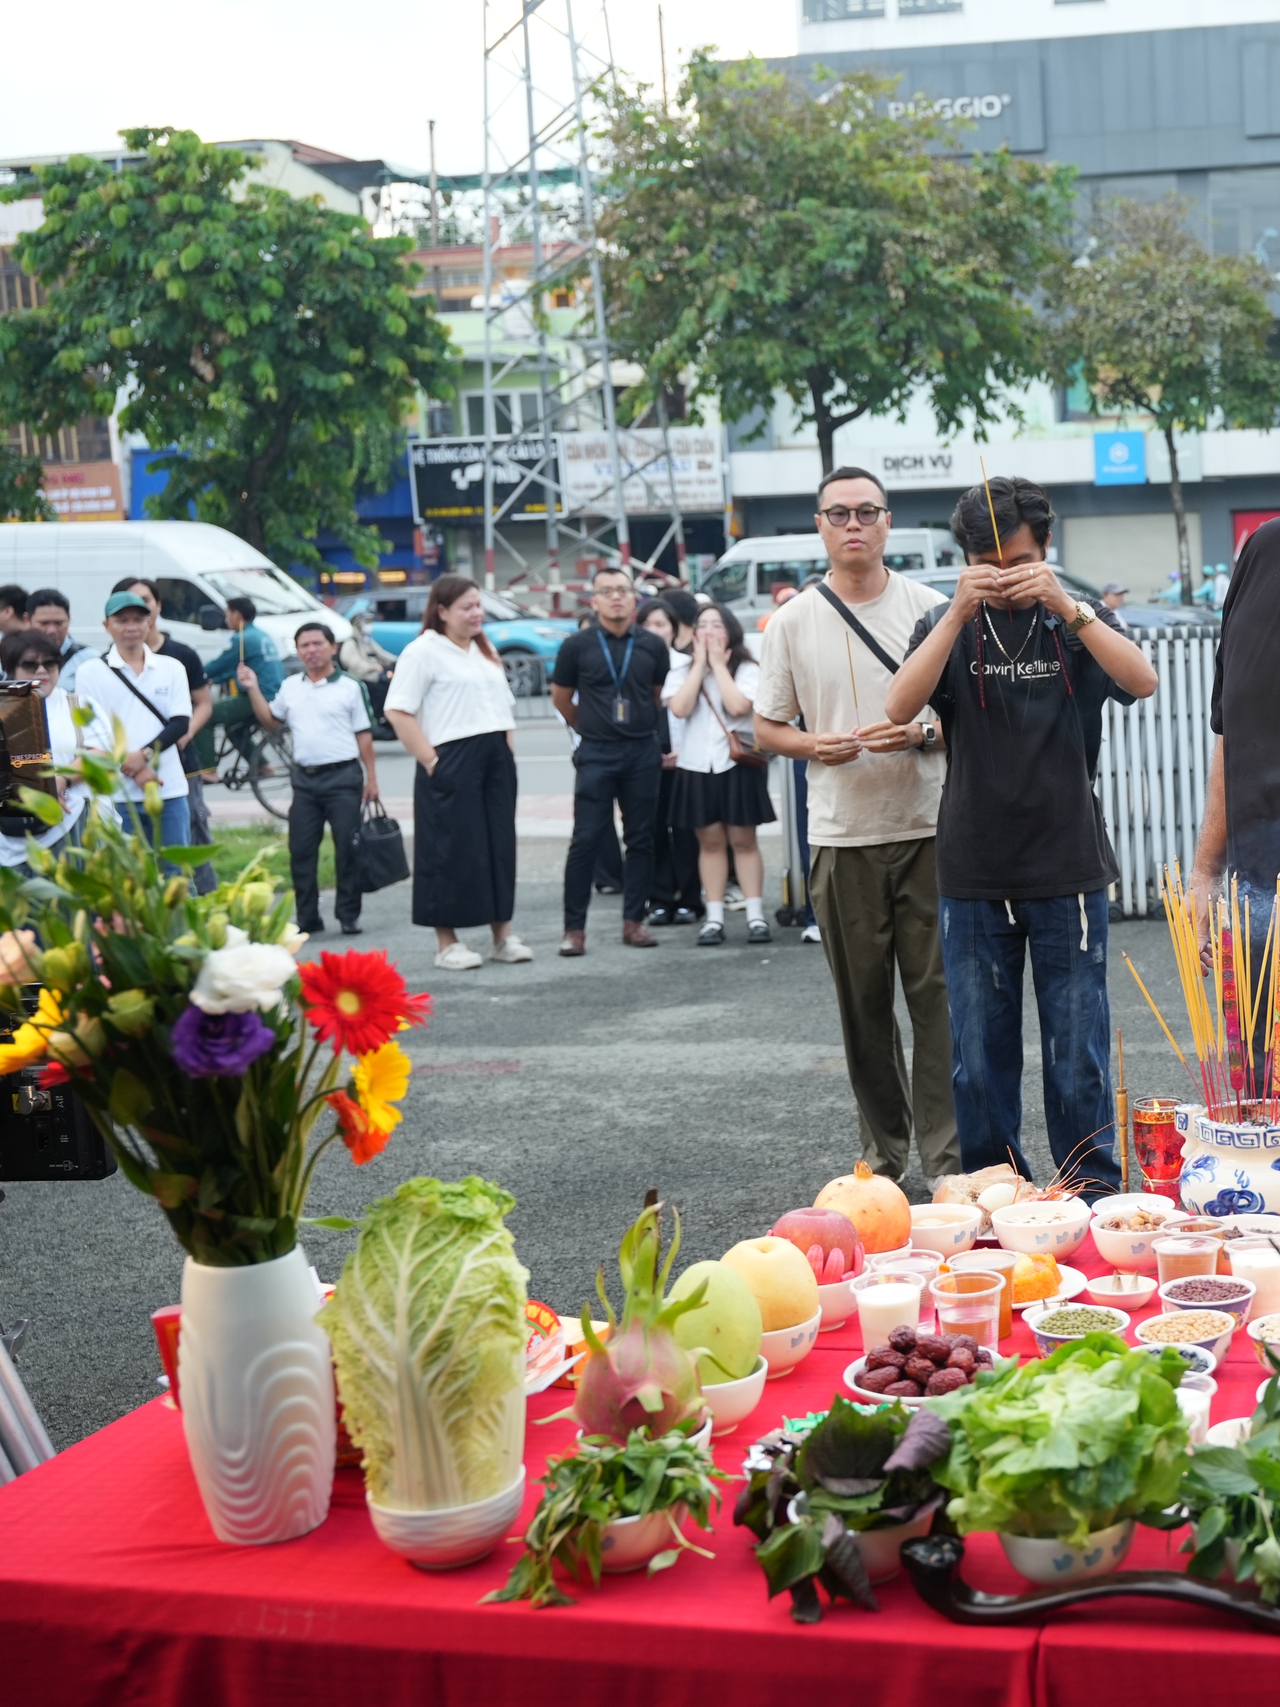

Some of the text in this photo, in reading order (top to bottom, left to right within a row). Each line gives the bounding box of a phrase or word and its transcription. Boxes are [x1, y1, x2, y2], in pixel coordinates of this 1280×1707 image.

[883, 453, 953, 474] DỊCH VỤ
[969, 661, 1013, 676] Calvin
